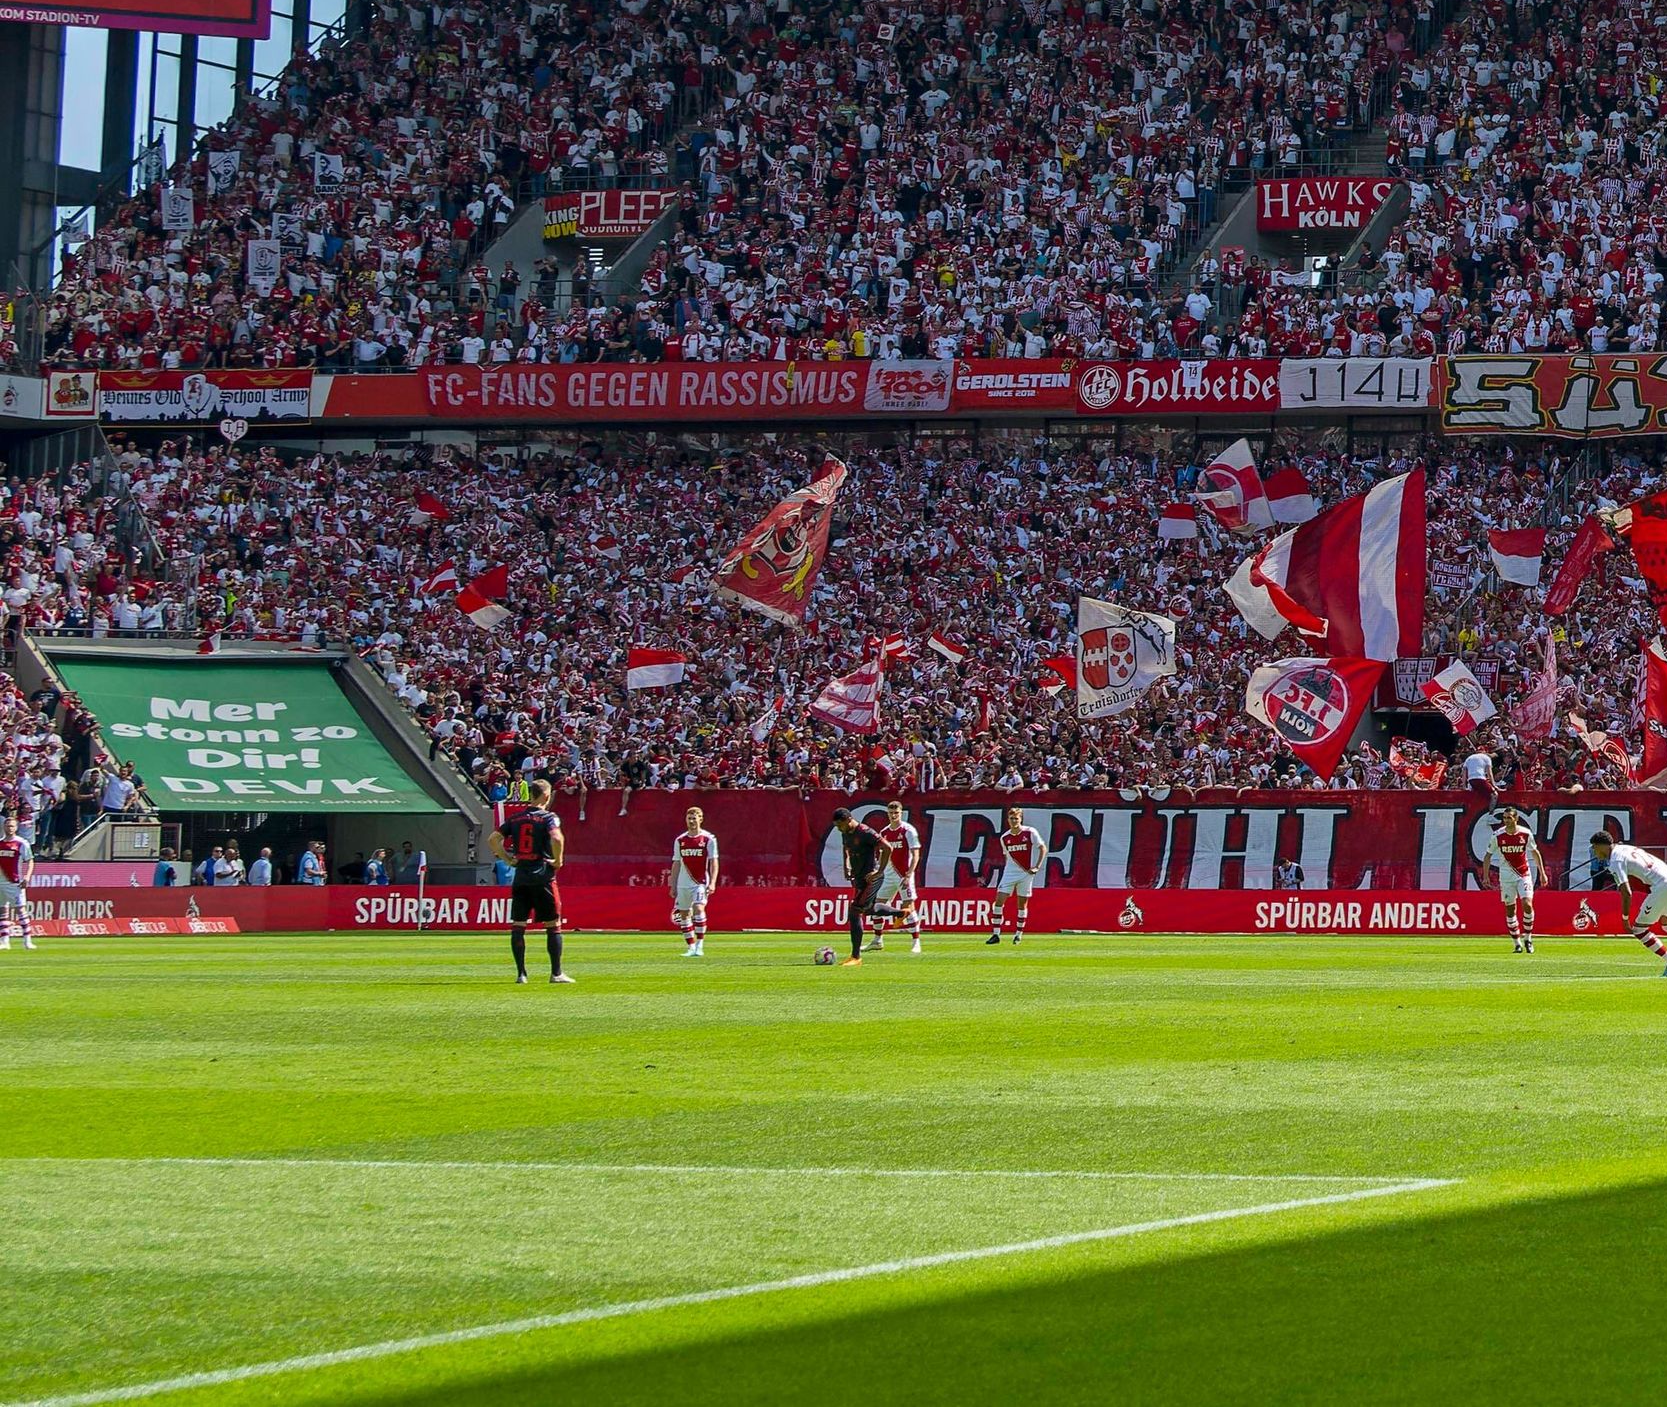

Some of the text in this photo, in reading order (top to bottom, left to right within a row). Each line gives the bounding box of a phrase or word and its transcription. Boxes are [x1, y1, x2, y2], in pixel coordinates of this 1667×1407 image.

[26, 10, 100, 25] STADION-TV
[1299, 206, 1360, 228] KÖLN
[428, 370, 858, 407] FC-FANS GEGEN RASSISMUS
[956, 373, 1071, 391] GEROLSTEIN
[155, 390, 180, 405] Old
[220, 390, 266, 406] School
[272, 389, 309, 406] Army
[988, 390, 1013, 398] SINCE
[150, 696, 288, 723] Mer
[110, 722, 358, 743] stonn zo
[187, 748, 322, 769] Dir!
[160, 777, 396, 794] DEVK
[520, 823, 534, 854] 6
[1007, 844, 1029, 854] REWE
[1501, 845, 1526, 854] REWE
[26, 875, 81, 887] NDERS
[355, 893, 470, 924] SPÜRBAR
[1256, 898, 1467, 930] SPÜRBAR ANDERS.
